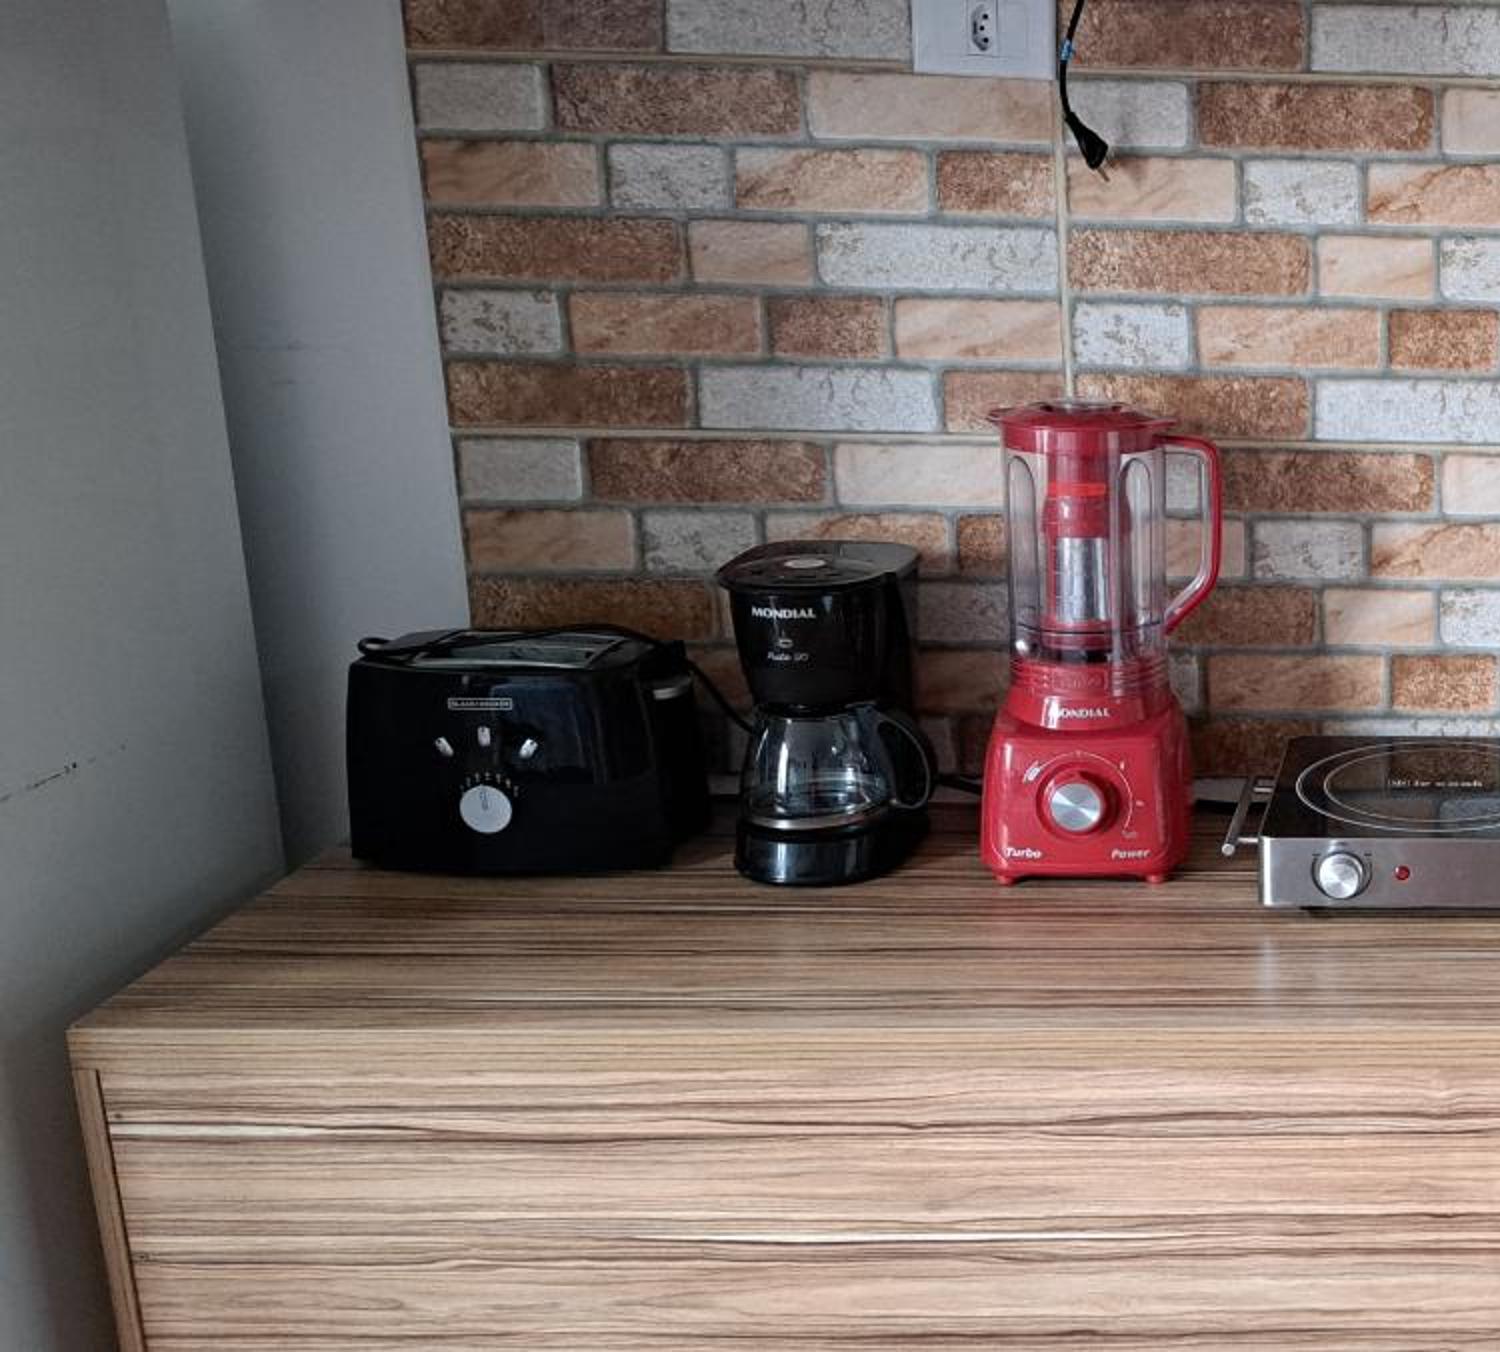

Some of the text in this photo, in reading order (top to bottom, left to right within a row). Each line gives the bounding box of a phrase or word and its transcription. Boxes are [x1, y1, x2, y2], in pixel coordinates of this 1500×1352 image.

[751, 606, 817, 619] MONDIAL
[1004, 847, 1042, 859] Turbo
[1111, 848, 1150, 860] Power
